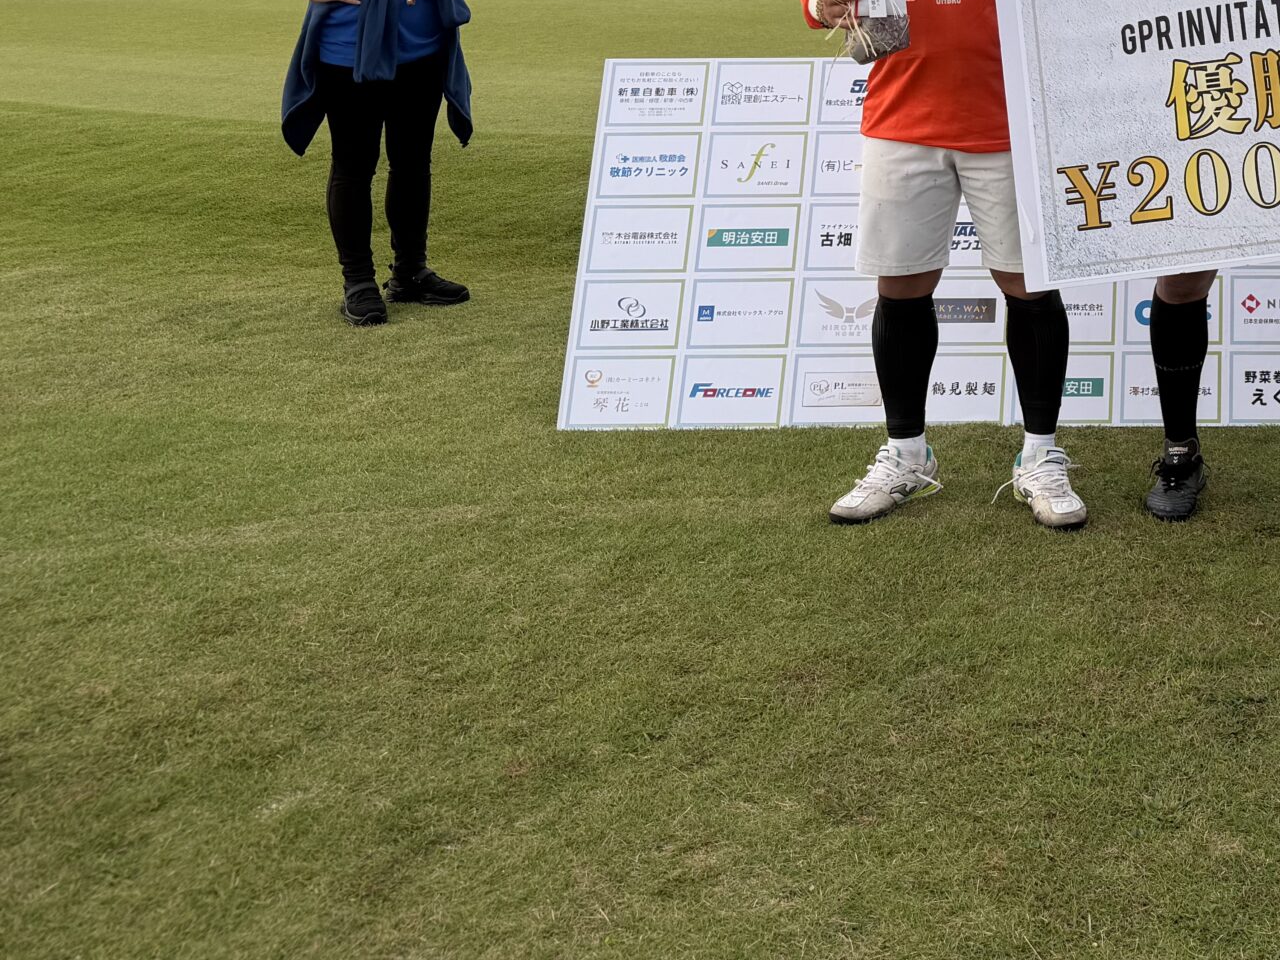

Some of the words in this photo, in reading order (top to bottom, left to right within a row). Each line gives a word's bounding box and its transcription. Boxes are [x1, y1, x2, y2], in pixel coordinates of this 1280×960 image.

[1120, 15, 1171, 55] GPR
[609, 166, 689, 178] 敬節クリニック
[820, 160, 863, 172] (有)ビー
[722, 231, 778, 245] 明治安田
[820, 233, 852, 247] 古畑
[590, 318, 669, 331] 小野工業株式会社
[689, 382, 775, 398] FORCEONE
[932, 381, 996, 396] 鶴見製麺
[1065, 380, 1093, 395] 安田
